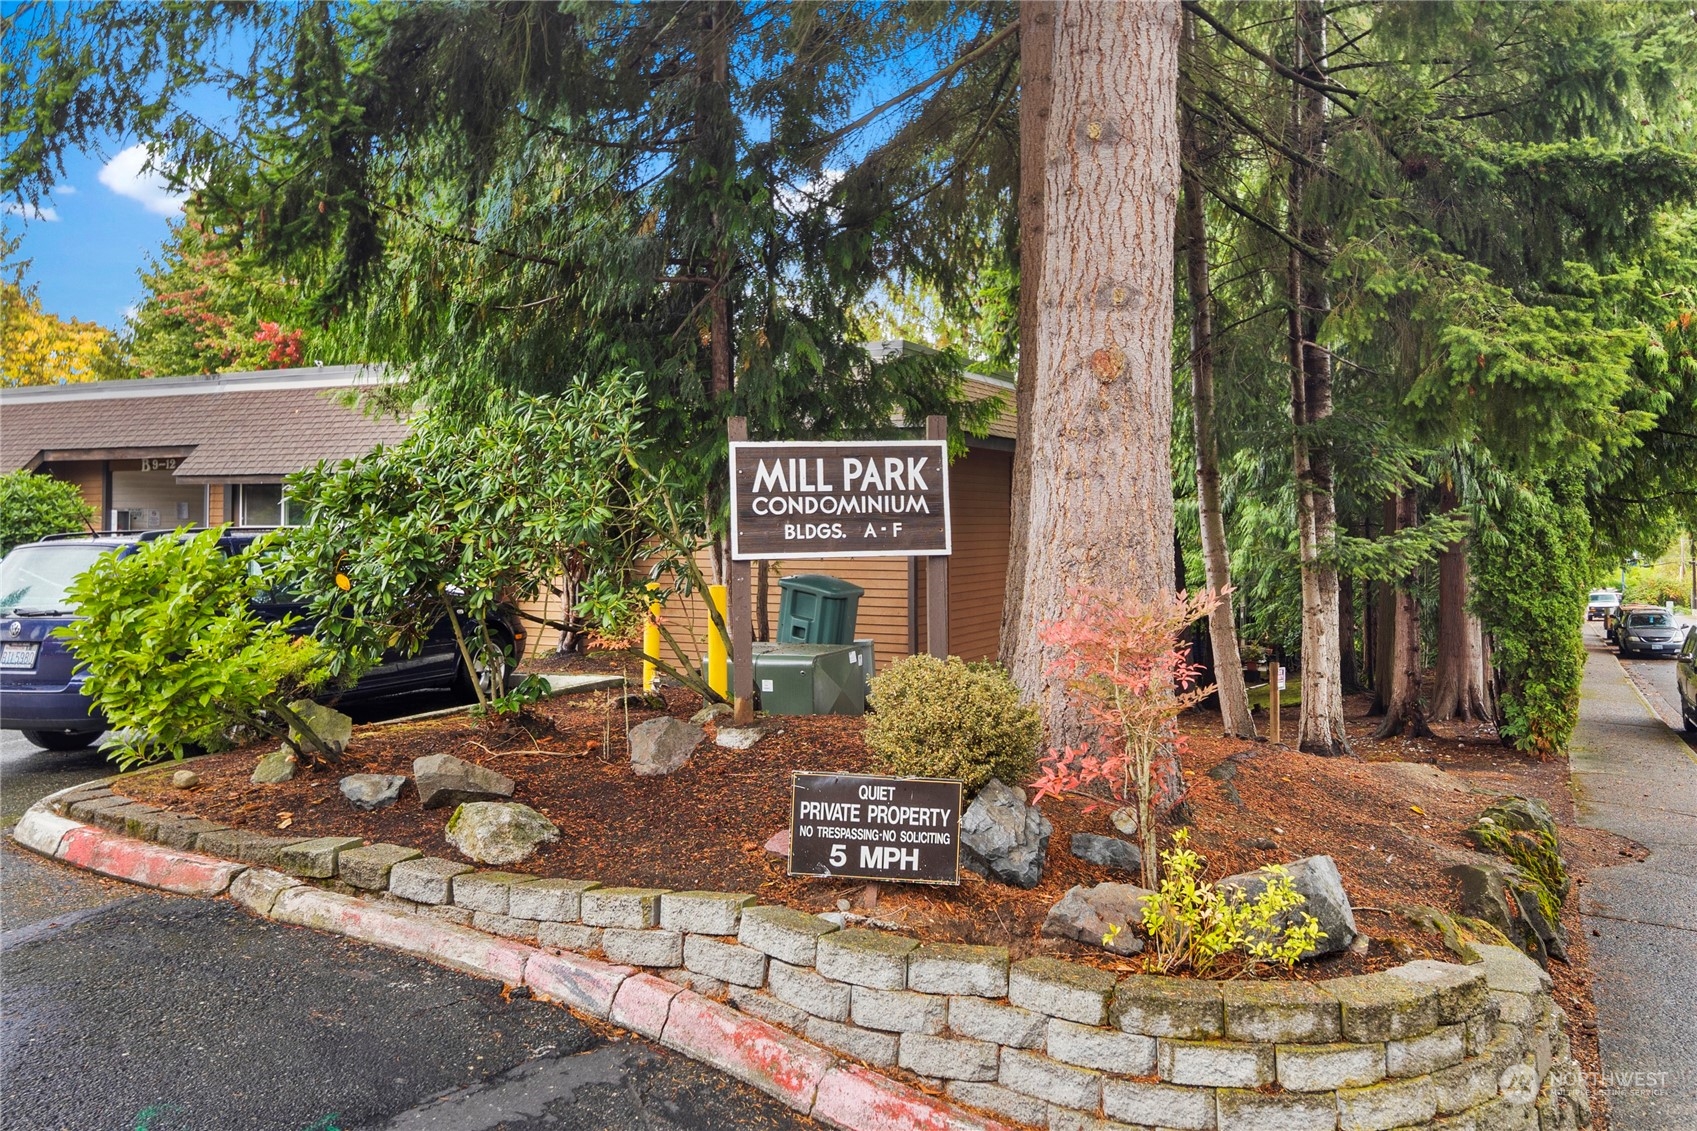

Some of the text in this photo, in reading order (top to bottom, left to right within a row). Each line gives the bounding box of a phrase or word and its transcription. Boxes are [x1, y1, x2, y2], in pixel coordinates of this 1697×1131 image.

[752, 457, 928, 493] MILL PARK
[752, 495, 930, 516] CONDOMINIUM
[784, 523, 846, 540] BLDGS.
[858, 785, 896, 800] QUIET
[800, 801, 950, 827] PRIVATE PROPERTY
[800, 825, 814, 838] NO
[900, 830, 950, 844] SOLICITING
[829, 844, 920, 871] 5 MPH
